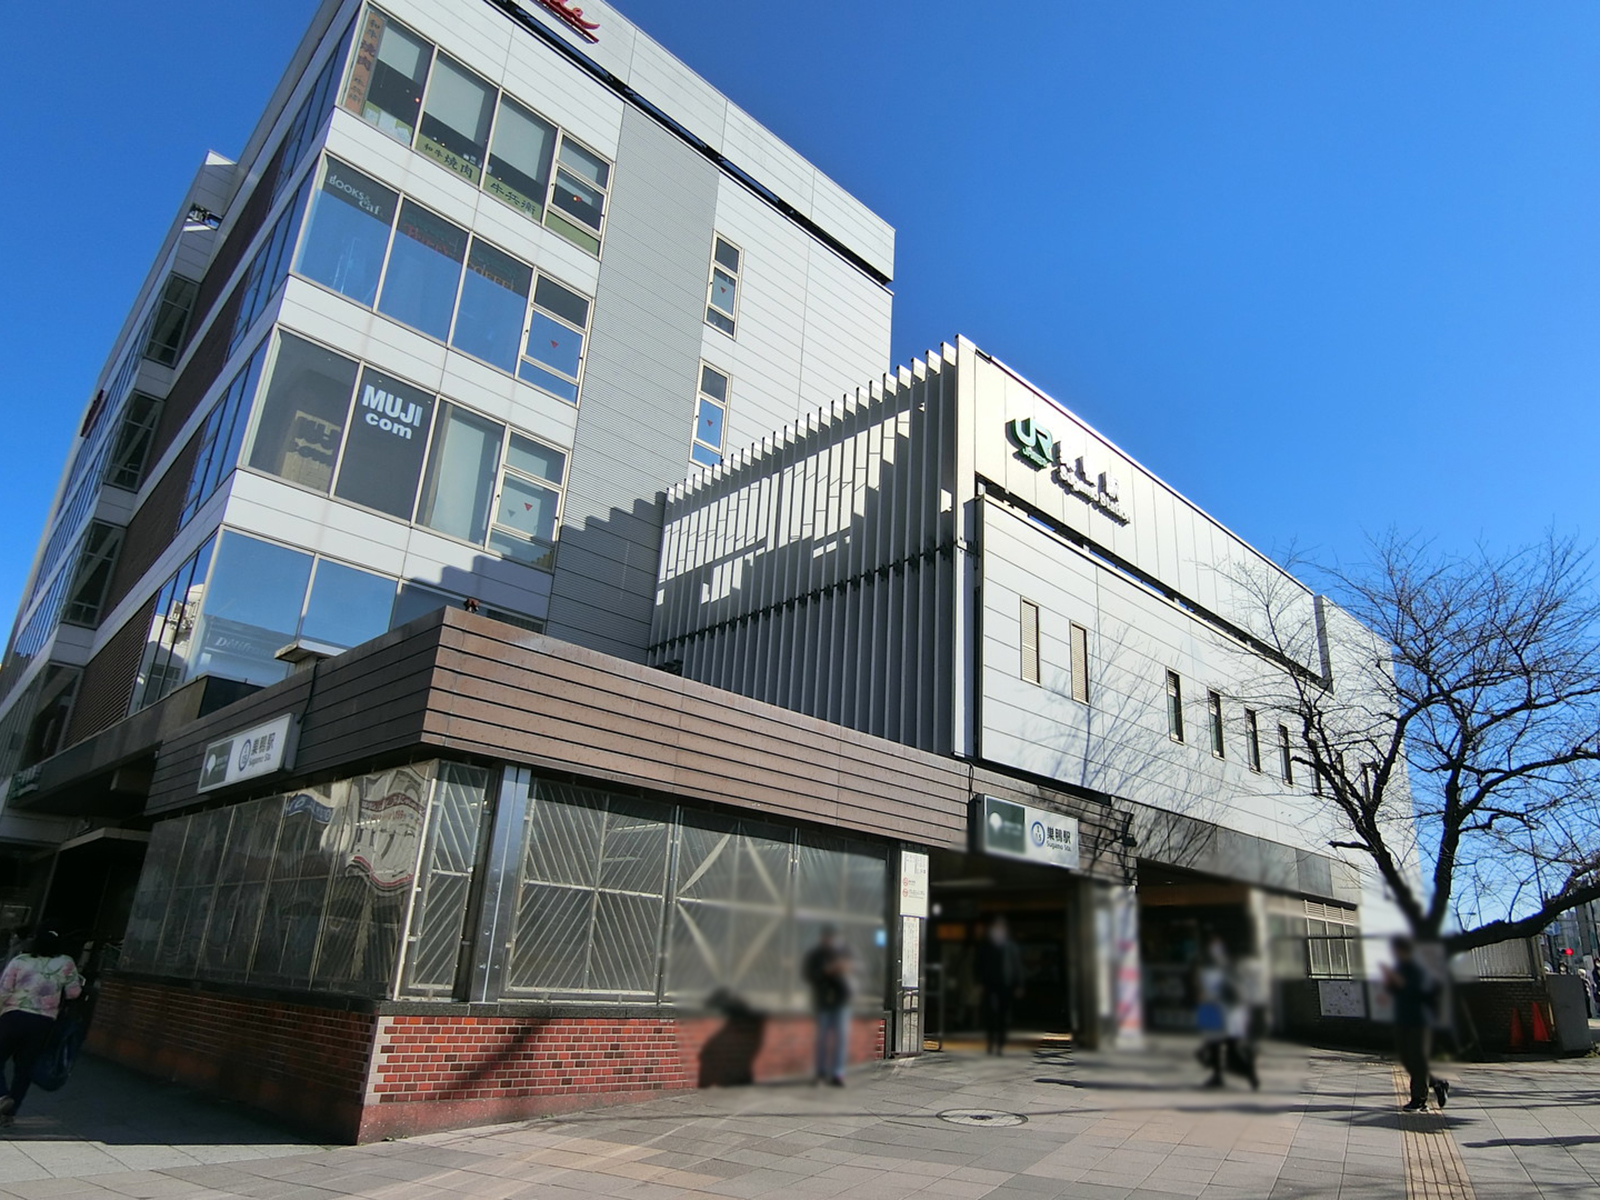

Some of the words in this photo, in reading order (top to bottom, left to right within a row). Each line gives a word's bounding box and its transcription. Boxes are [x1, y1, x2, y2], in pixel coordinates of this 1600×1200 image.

[362, 384, 423, 428] MUJI
[365, 412, 412, 440] com
[1047, 826, 1071, 844] 巣鴨駅
